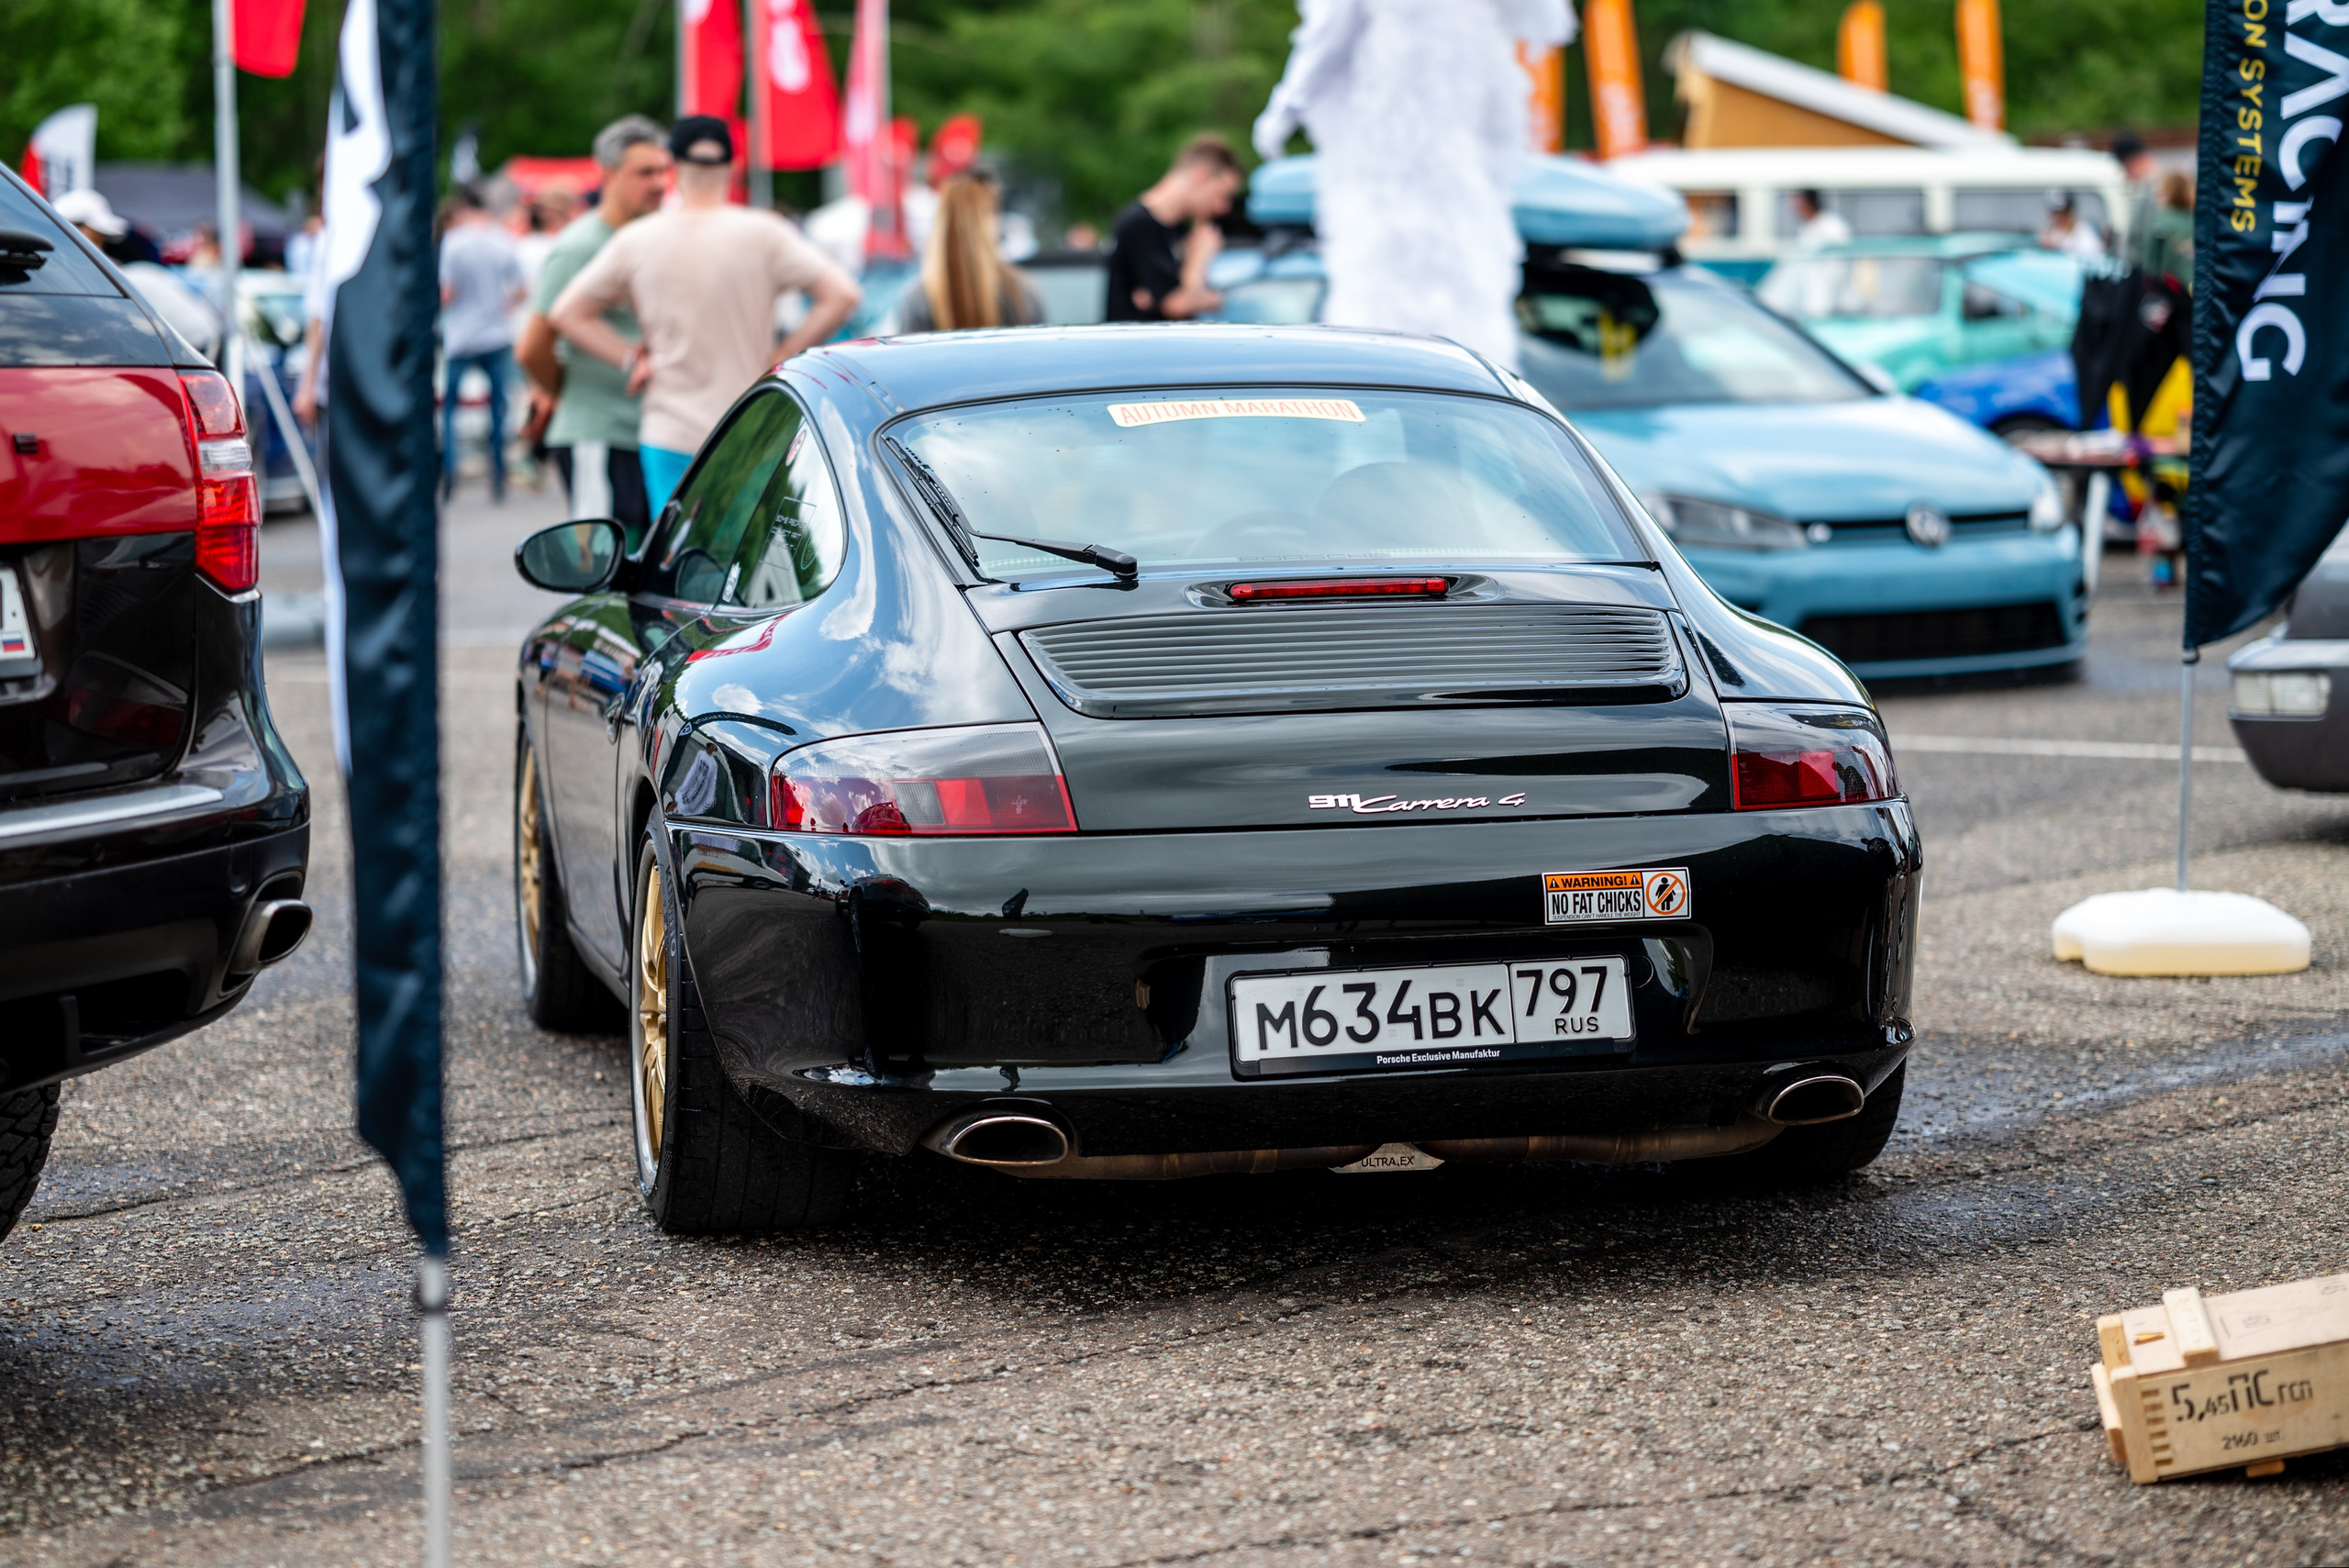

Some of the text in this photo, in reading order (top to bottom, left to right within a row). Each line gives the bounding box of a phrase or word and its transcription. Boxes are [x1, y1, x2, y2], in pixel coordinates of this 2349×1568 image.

[2231, 57, 2266, 233] SYSTEMS
[1119, 402, 1358, 424] AUTUMN MARATHON
[1308, 792, 1526, 814] 911 Carrera 4
[1561, 876, 1627, 888] WARNING!
[1552, 890, 1641, 915] NO FAT CHICKS
[1516, 965, 1608, 1017] 797
[1554, 1016, 1598, 1035] RUS
[1376, 1049, 1500, 1064] Porsche Exclusive Manufaktur
[1361, 1156, 1414, 1167] ULTRA.EX
